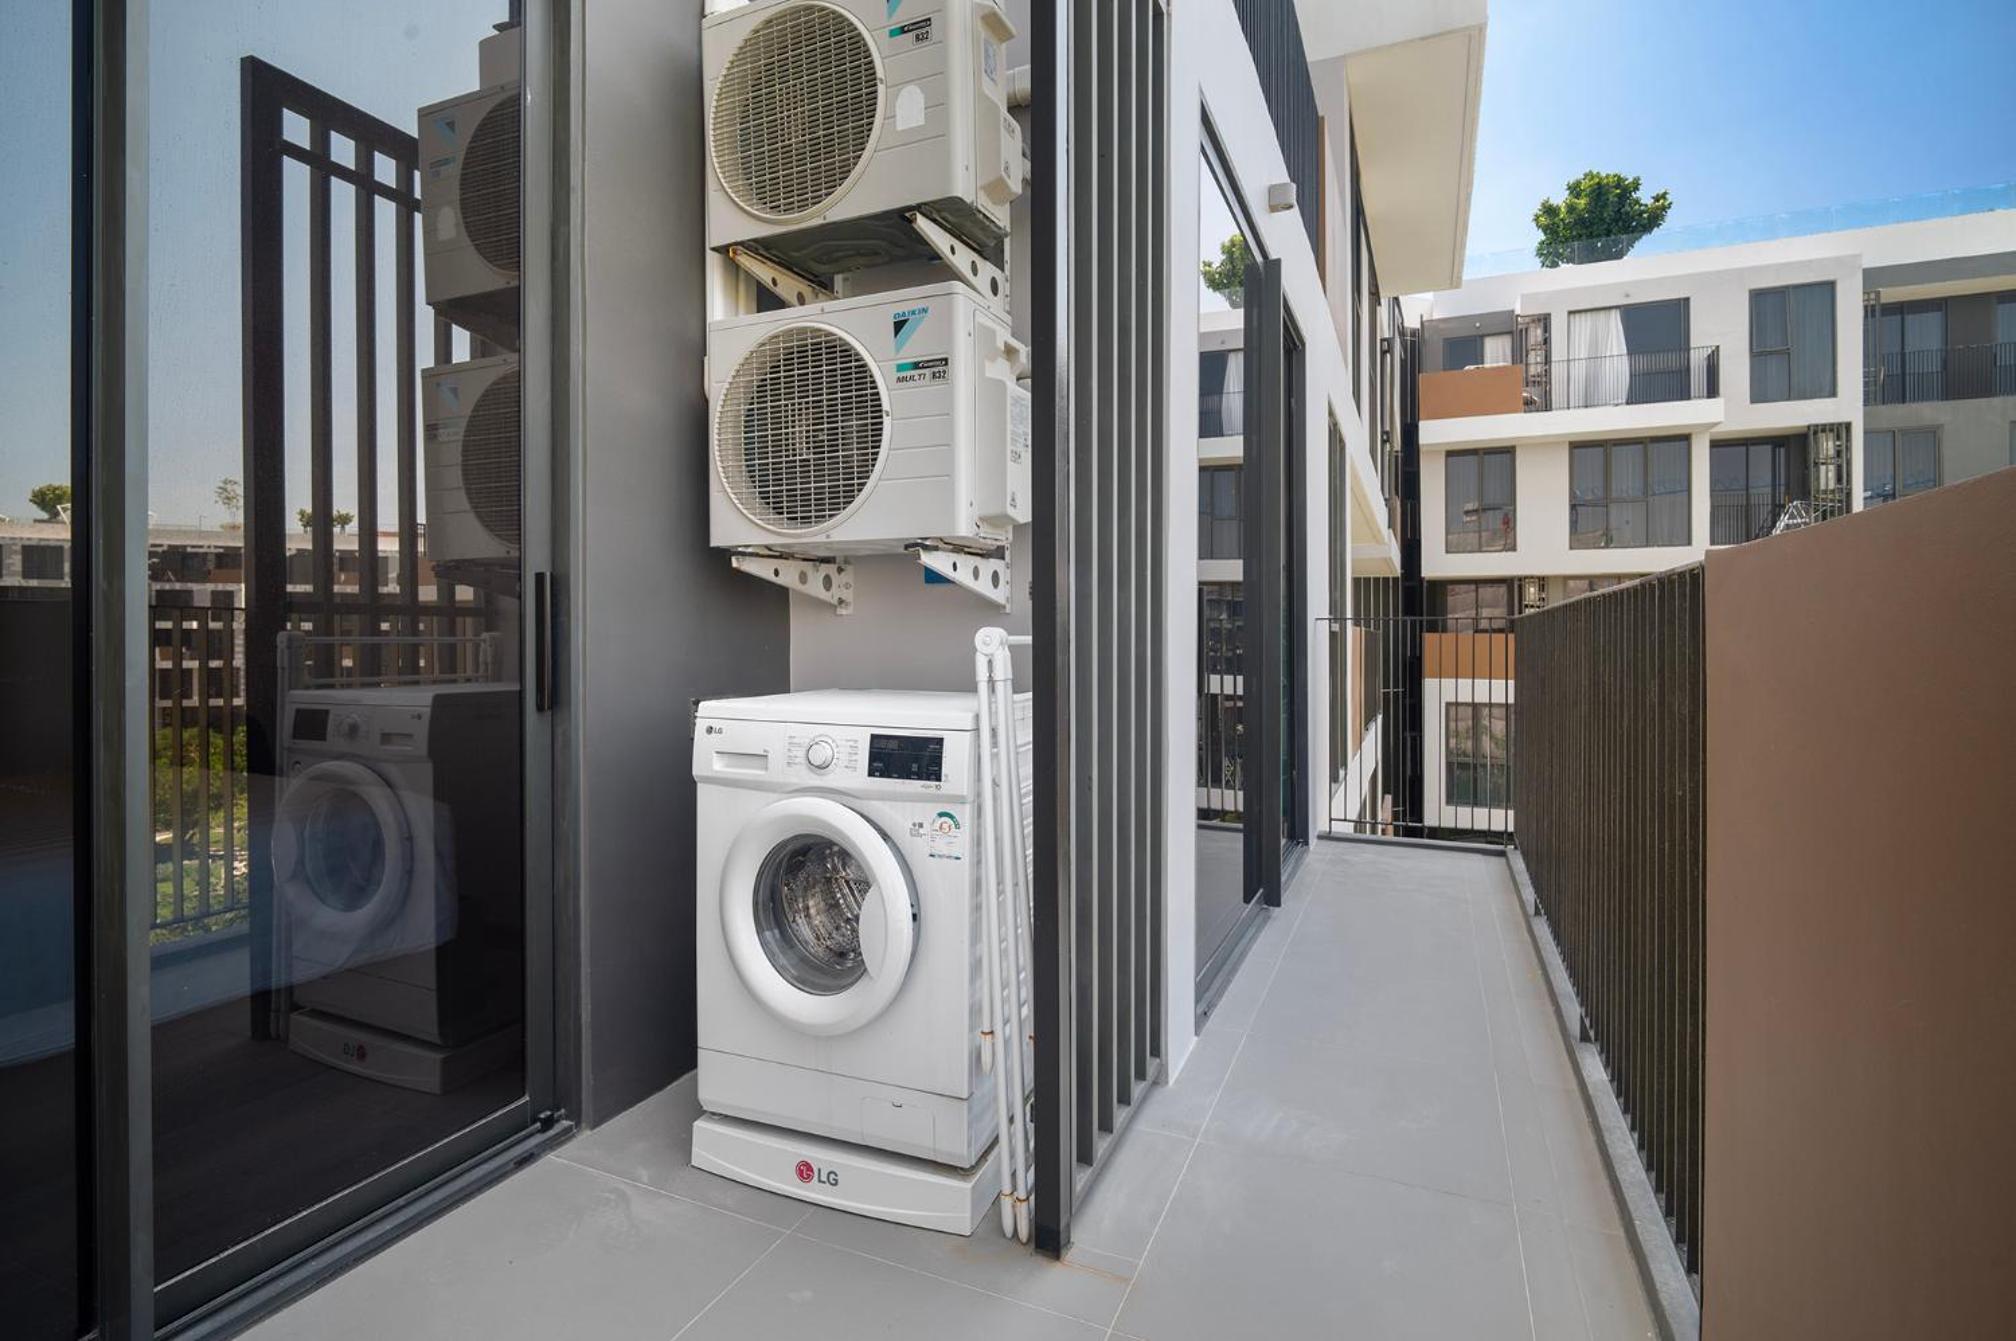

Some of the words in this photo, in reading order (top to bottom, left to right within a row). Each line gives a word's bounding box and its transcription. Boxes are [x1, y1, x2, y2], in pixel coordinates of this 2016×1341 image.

[893, 306, 929, 320] DAIKIN
[895, 372, 927, 384] MULTI
[817, 1167, 840, 1187] LG
